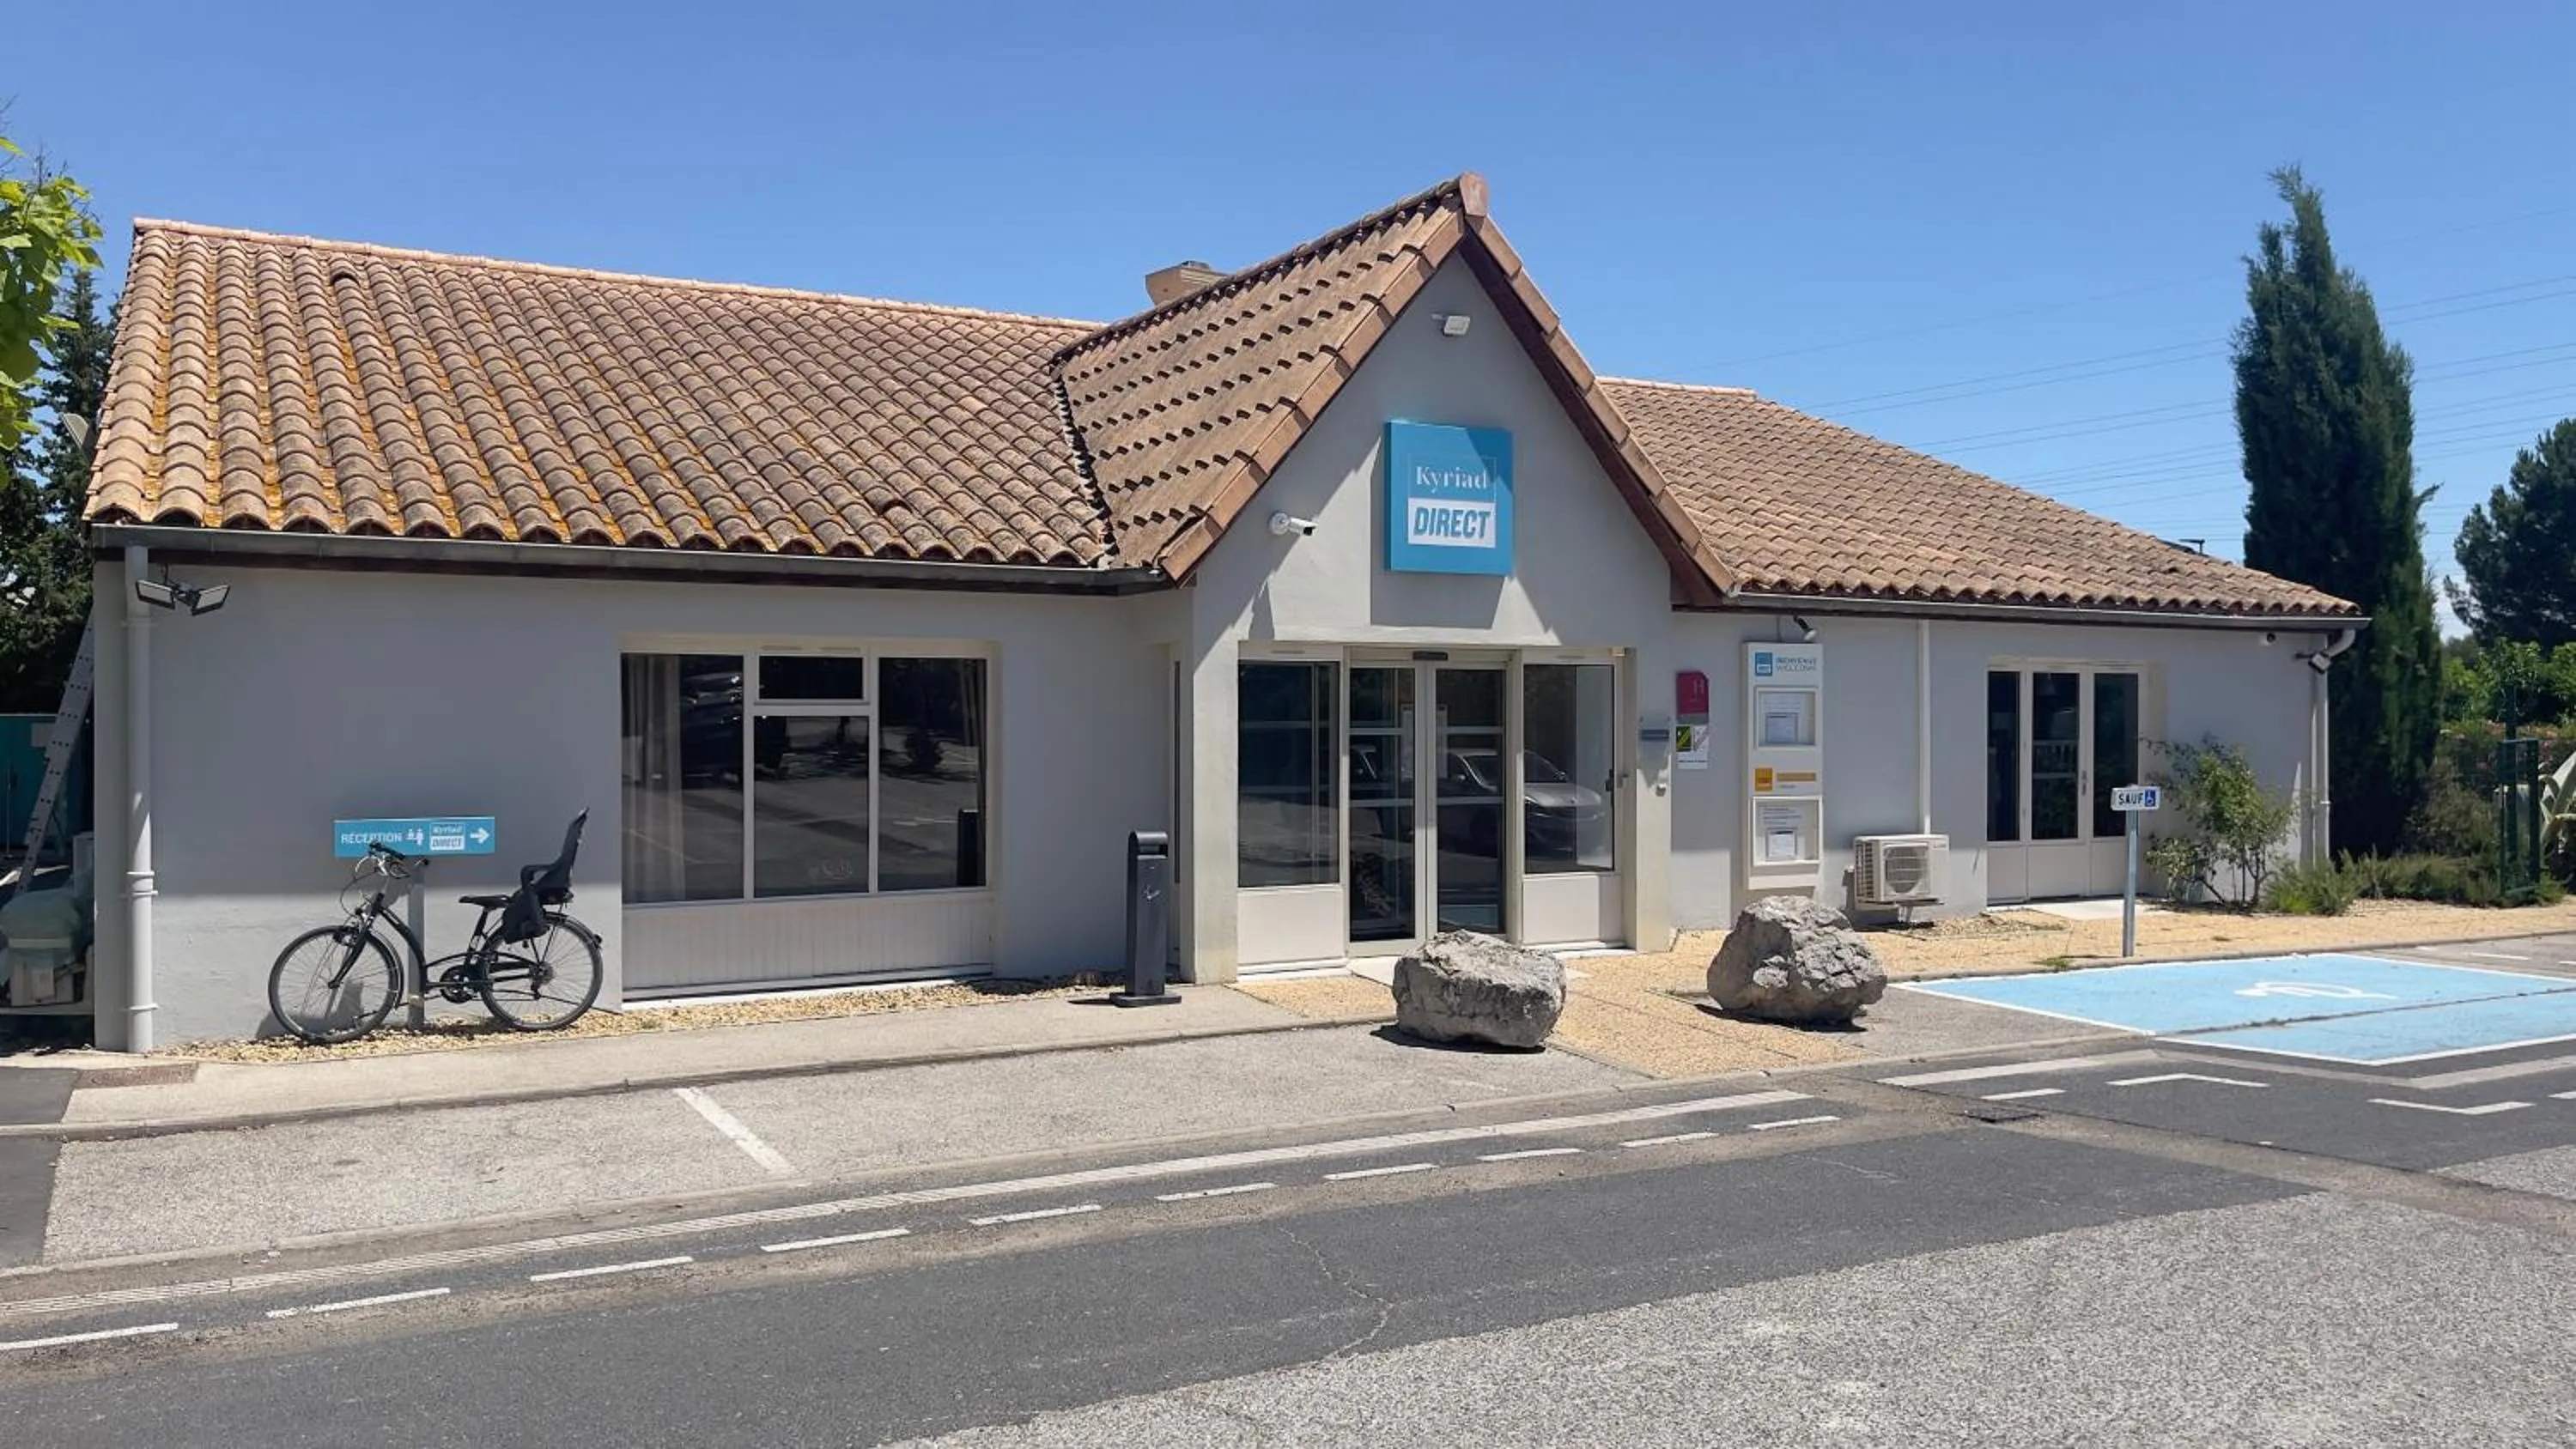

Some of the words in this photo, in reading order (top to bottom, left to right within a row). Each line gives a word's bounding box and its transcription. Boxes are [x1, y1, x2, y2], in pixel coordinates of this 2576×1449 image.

[1417, 465, 1487, 494] Kyriad
[1414, 506, 1491, 539] DIRECT
[2118, 792, 2144, 805] SAUF
